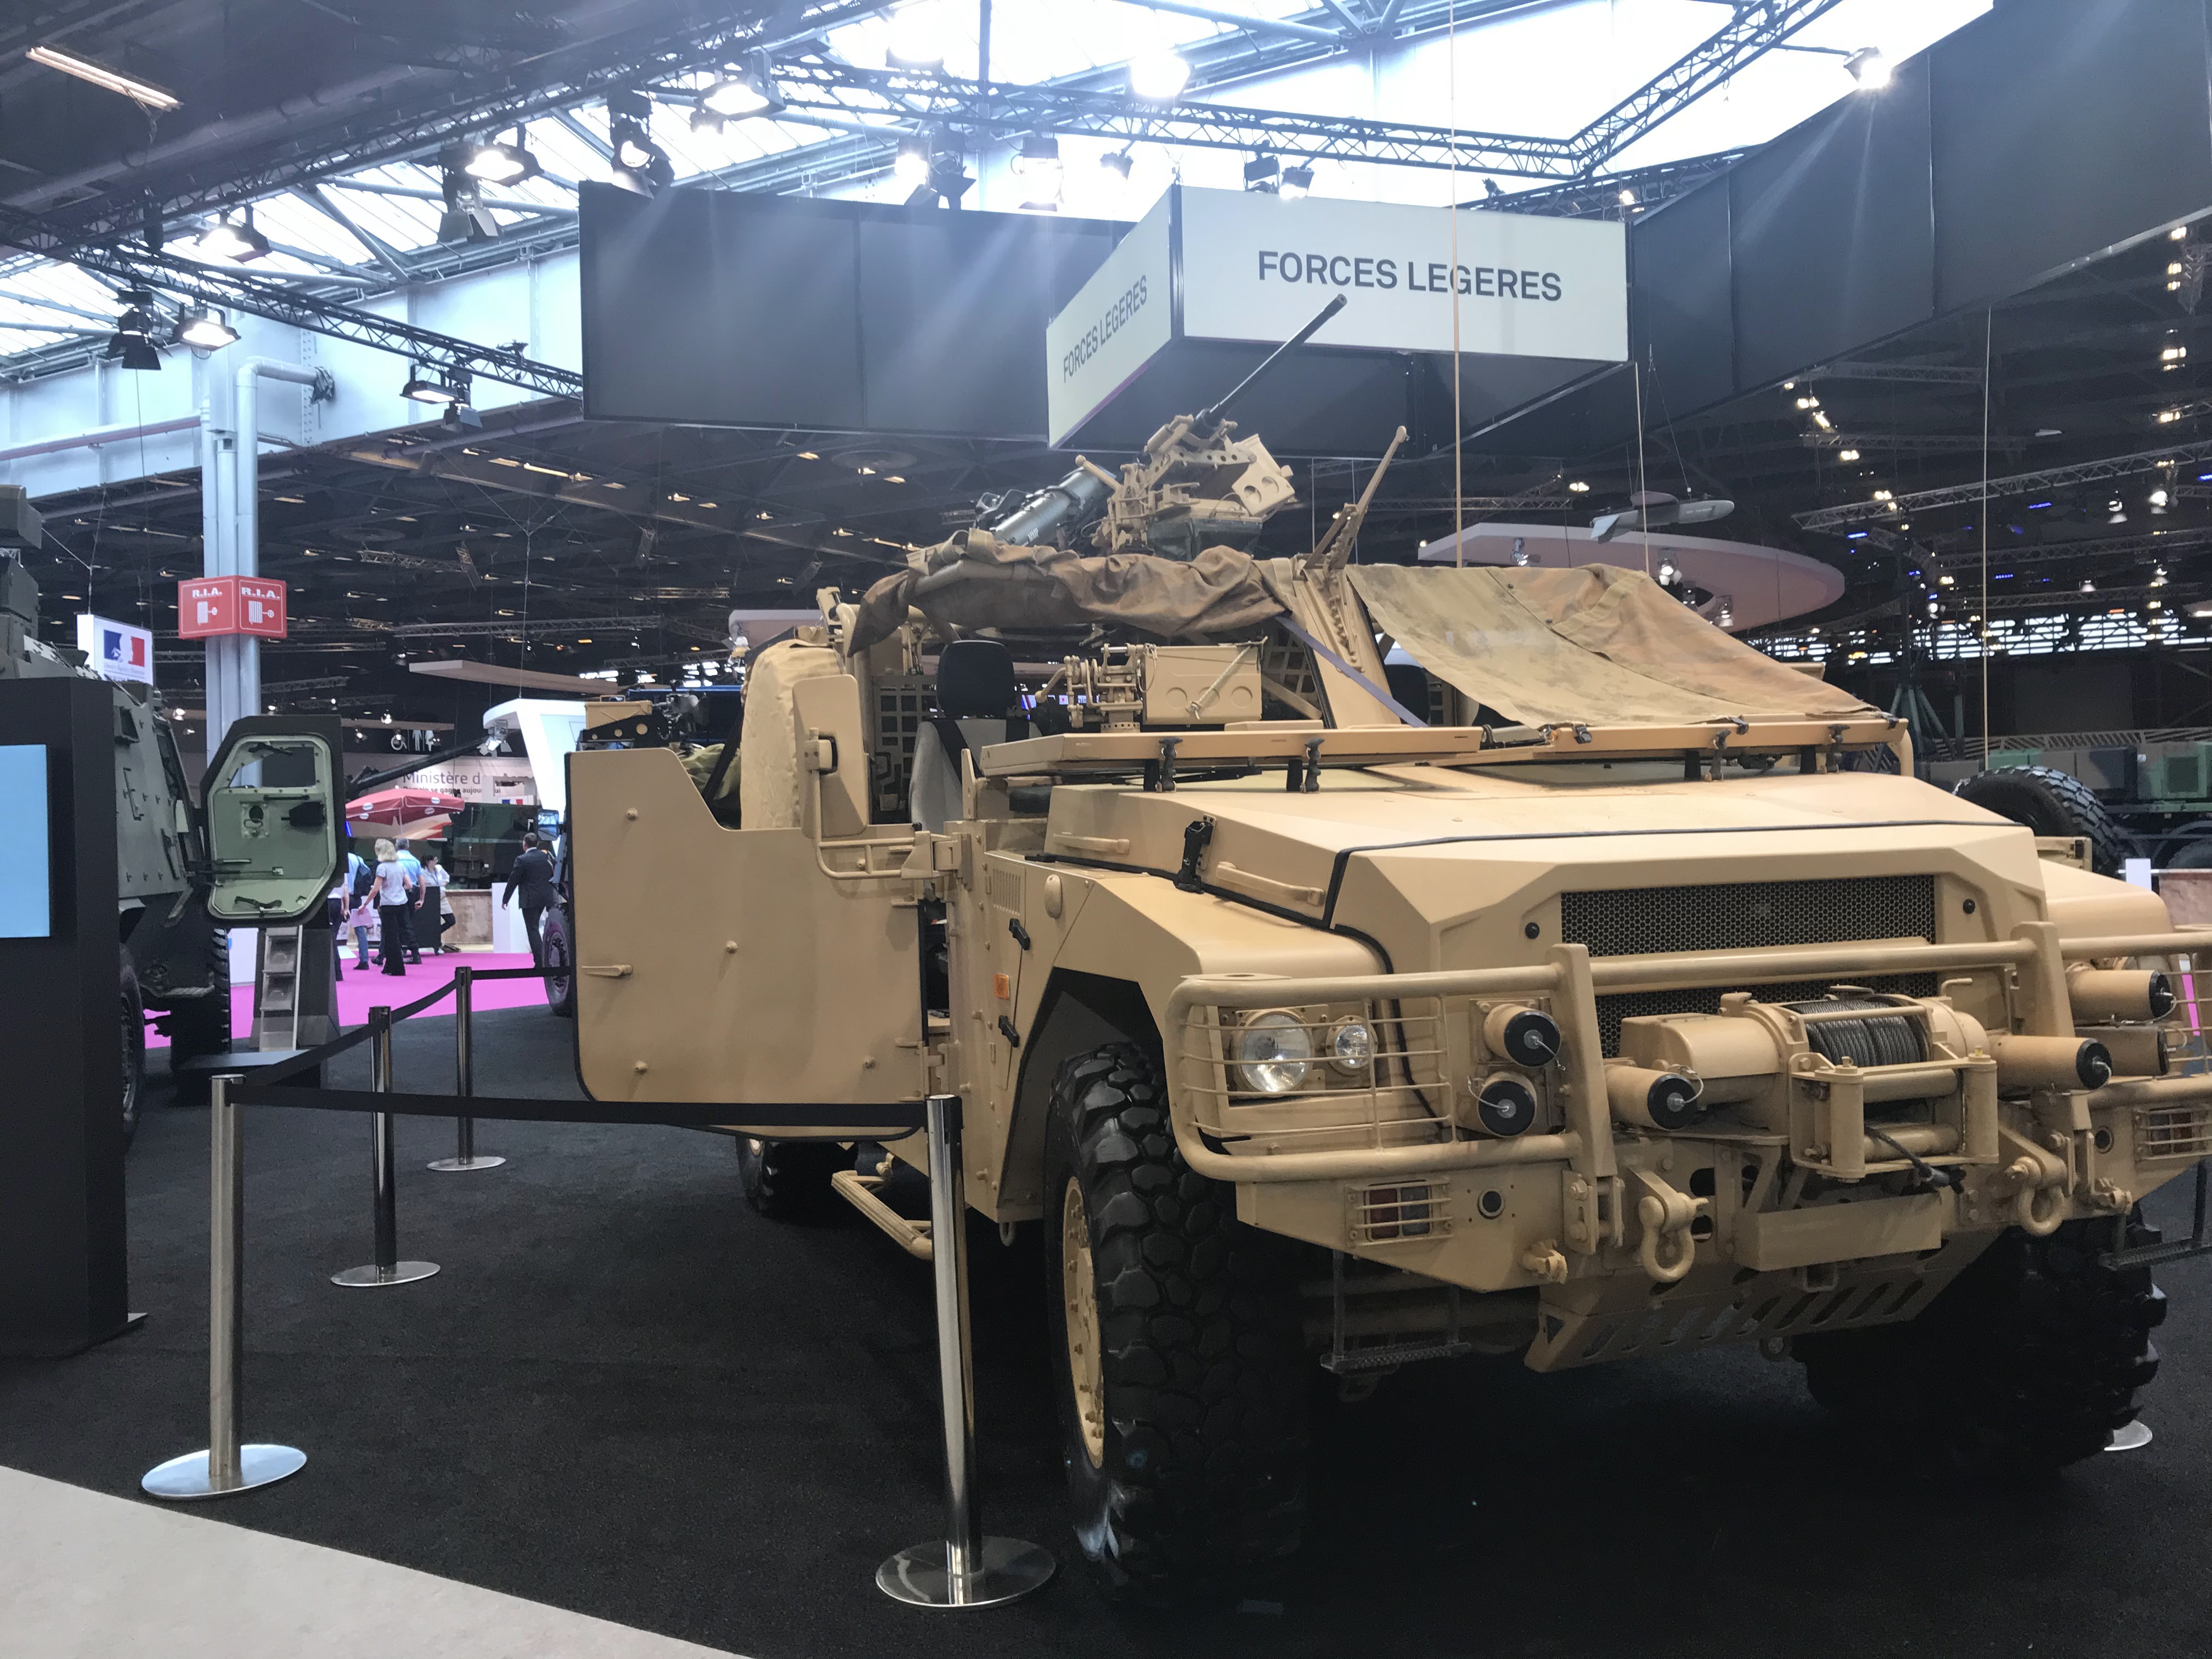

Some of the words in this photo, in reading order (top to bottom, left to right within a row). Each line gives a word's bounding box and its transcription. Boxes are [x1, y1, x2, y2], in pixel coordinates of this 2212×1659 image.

[1259, 250, 1398, 289] FORCES
[1408, 261, 1562, 302] LEGERES
[1063, 325, 1098, 383] FORCES
[1099, 274, 1147, 347] LEGERES
[192, 587, 223, 598] R.I.A.
[241, 586, 281, 600] R.I.A.
[403, 771, 468, 785] Ministère
